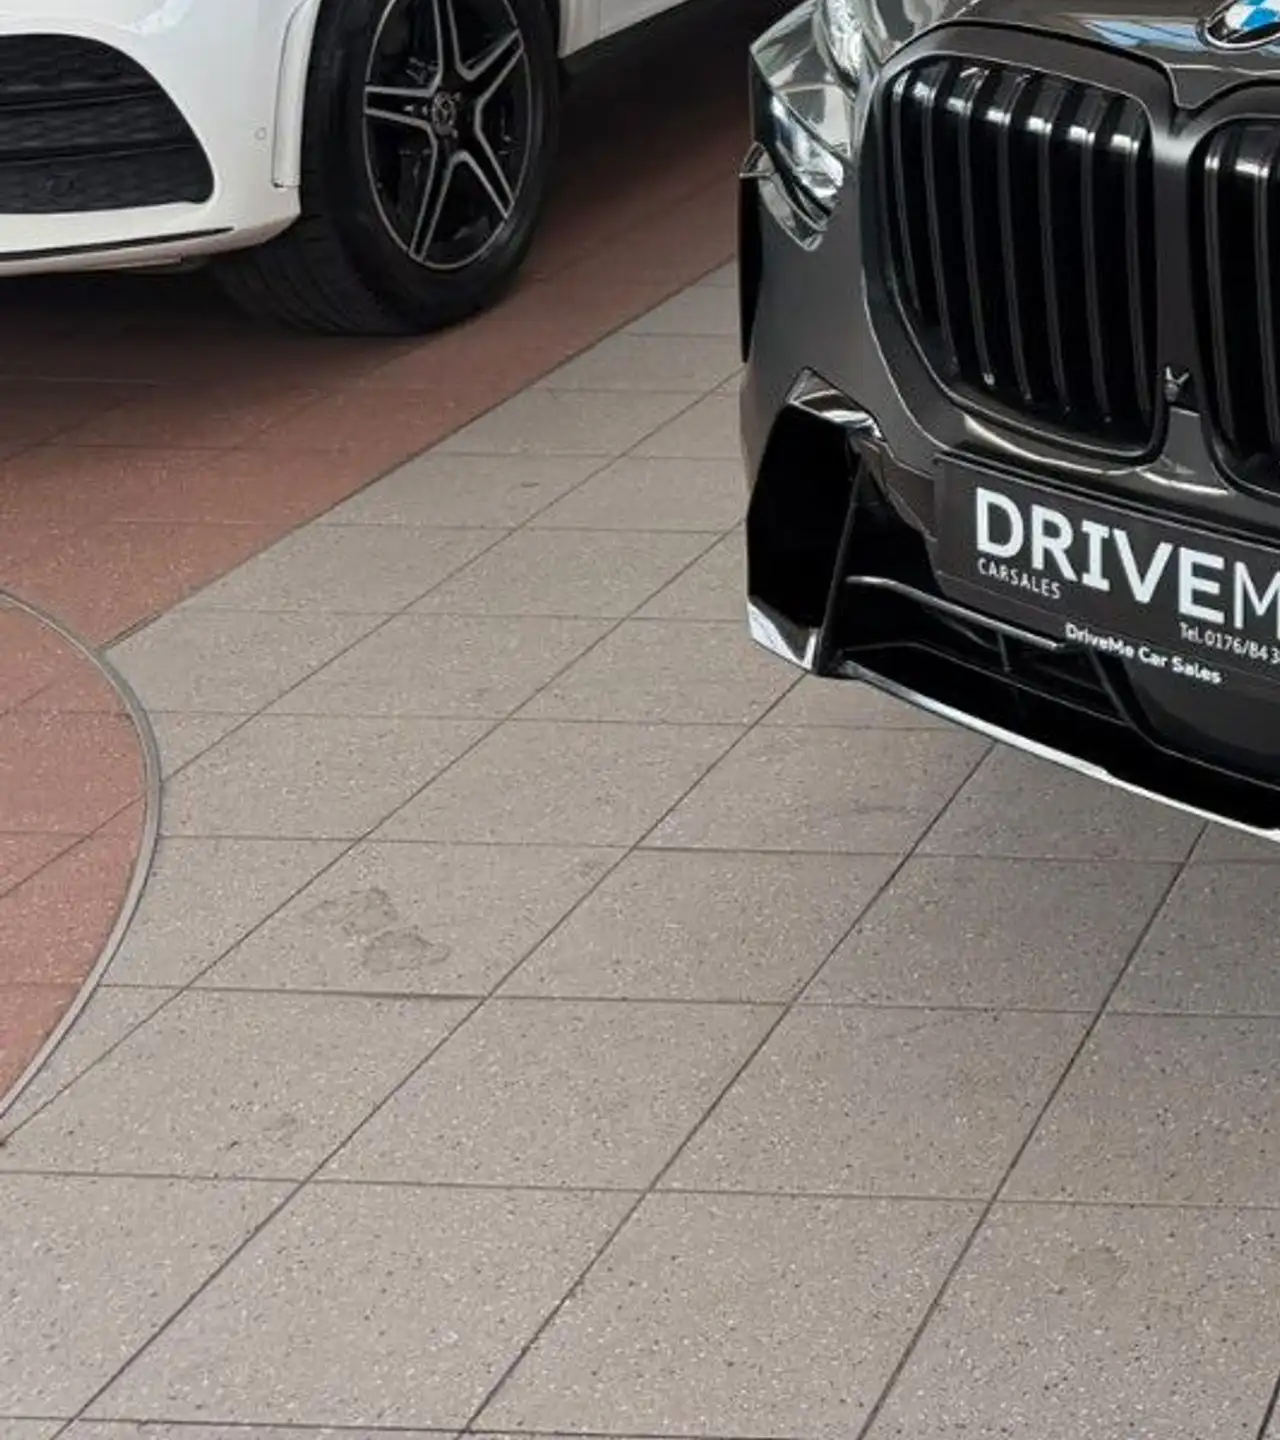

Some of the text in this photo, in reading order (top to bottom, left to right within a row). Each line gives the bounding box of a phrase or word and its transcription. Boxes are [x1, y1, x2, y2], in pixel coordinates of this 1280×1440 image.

[977, 556, 1062, 600] CARSALES
[1138, 646, 1169, 669] Car
[1172, 656, 1222, 685] Sales
